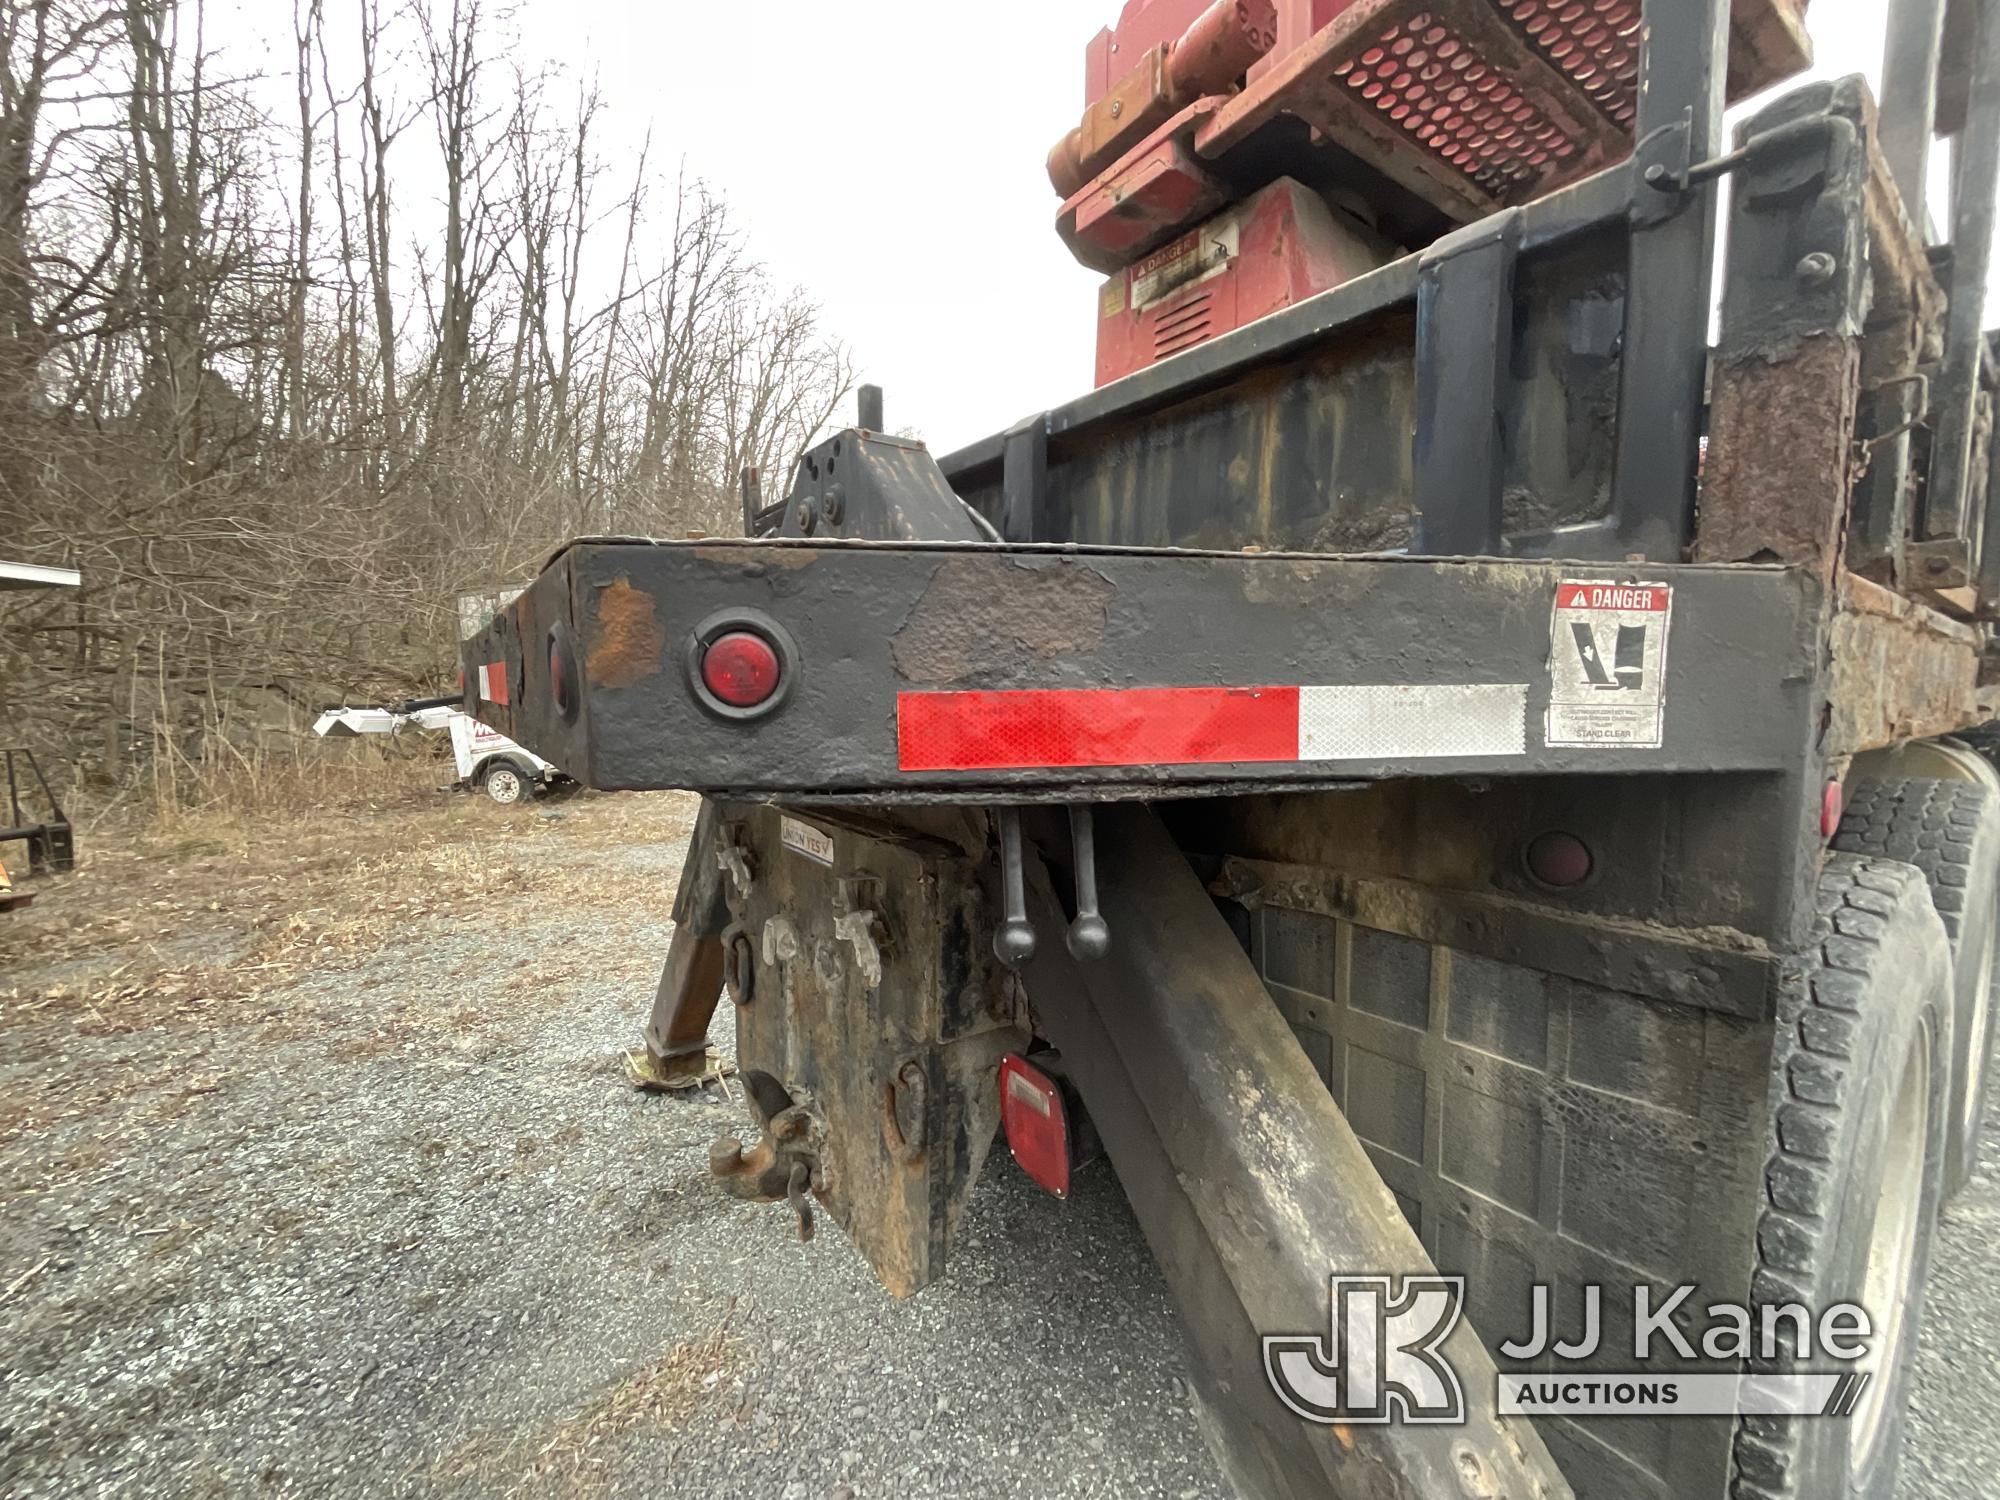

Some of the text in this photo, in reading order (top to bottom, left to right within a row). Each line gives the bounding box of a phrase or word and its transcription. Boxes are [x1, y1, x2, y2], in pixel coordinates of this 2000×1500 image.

[1148, 239, 1192, 270] DANGER
[1592, 588, 1652, 609] DANGER
[1576, 729, 1631, 738] STAND CLEAR
